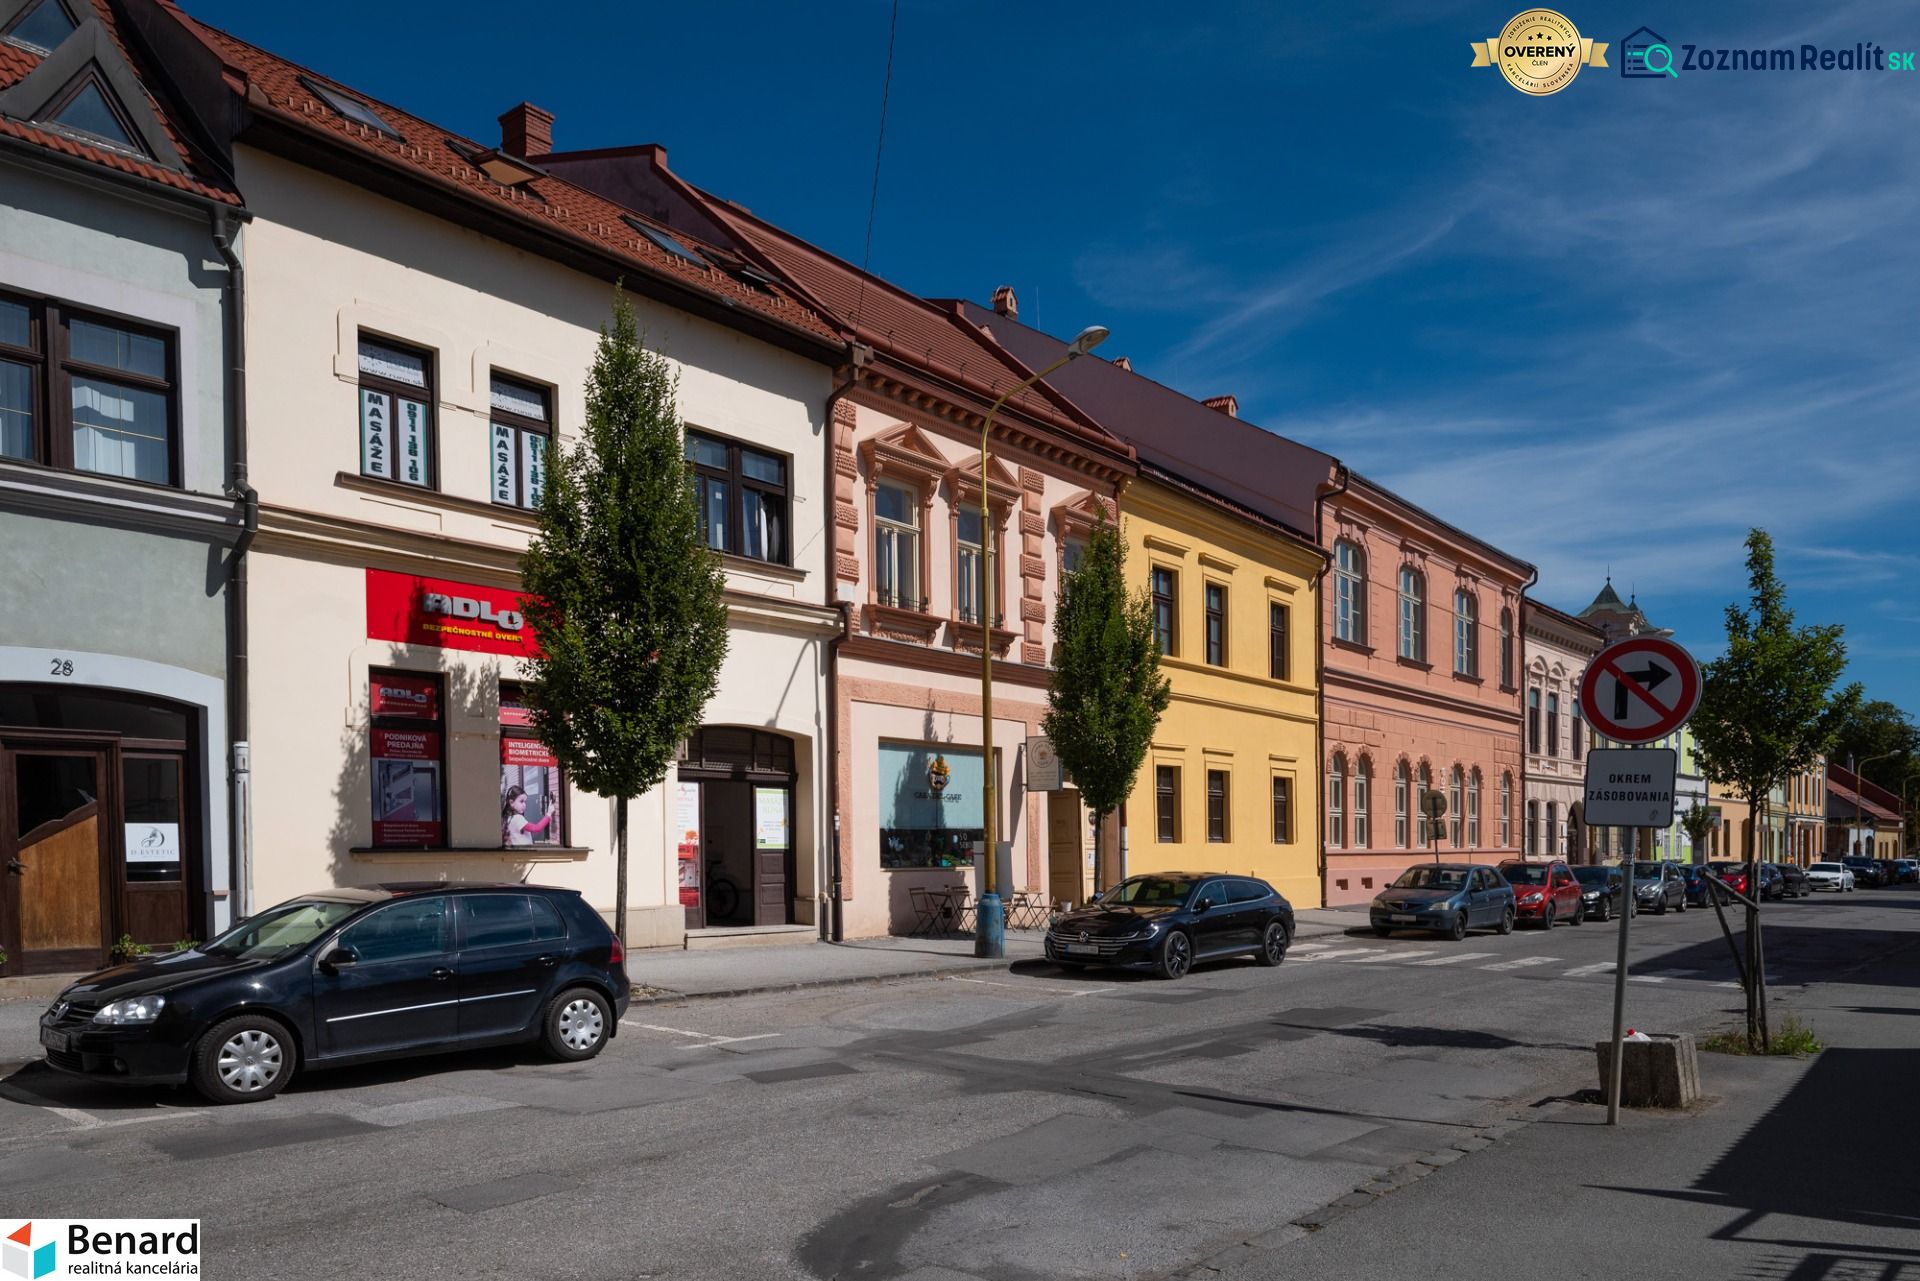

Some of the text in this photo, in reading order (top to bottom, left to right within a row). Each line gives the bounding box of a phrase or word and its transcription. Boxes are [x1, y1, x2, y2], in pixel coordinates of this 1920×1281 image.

[367, 392, 384, 473] MASÁŽE
[495, 426, 510, 501] MASÁŽE
[423, 592, 525, 631] ADLO
[422, 623, 494, 639] BEZPEČNOSTNÉ
[51, 657, 74, 677] 28
[379, 687, 428, 703] ADLO
[508, 741, 550, 751] INTELIGEN
[1608, 773, 1652, 784] OKREM
[1588, 787, 1670, 802] ZÁSOBOVANIA
